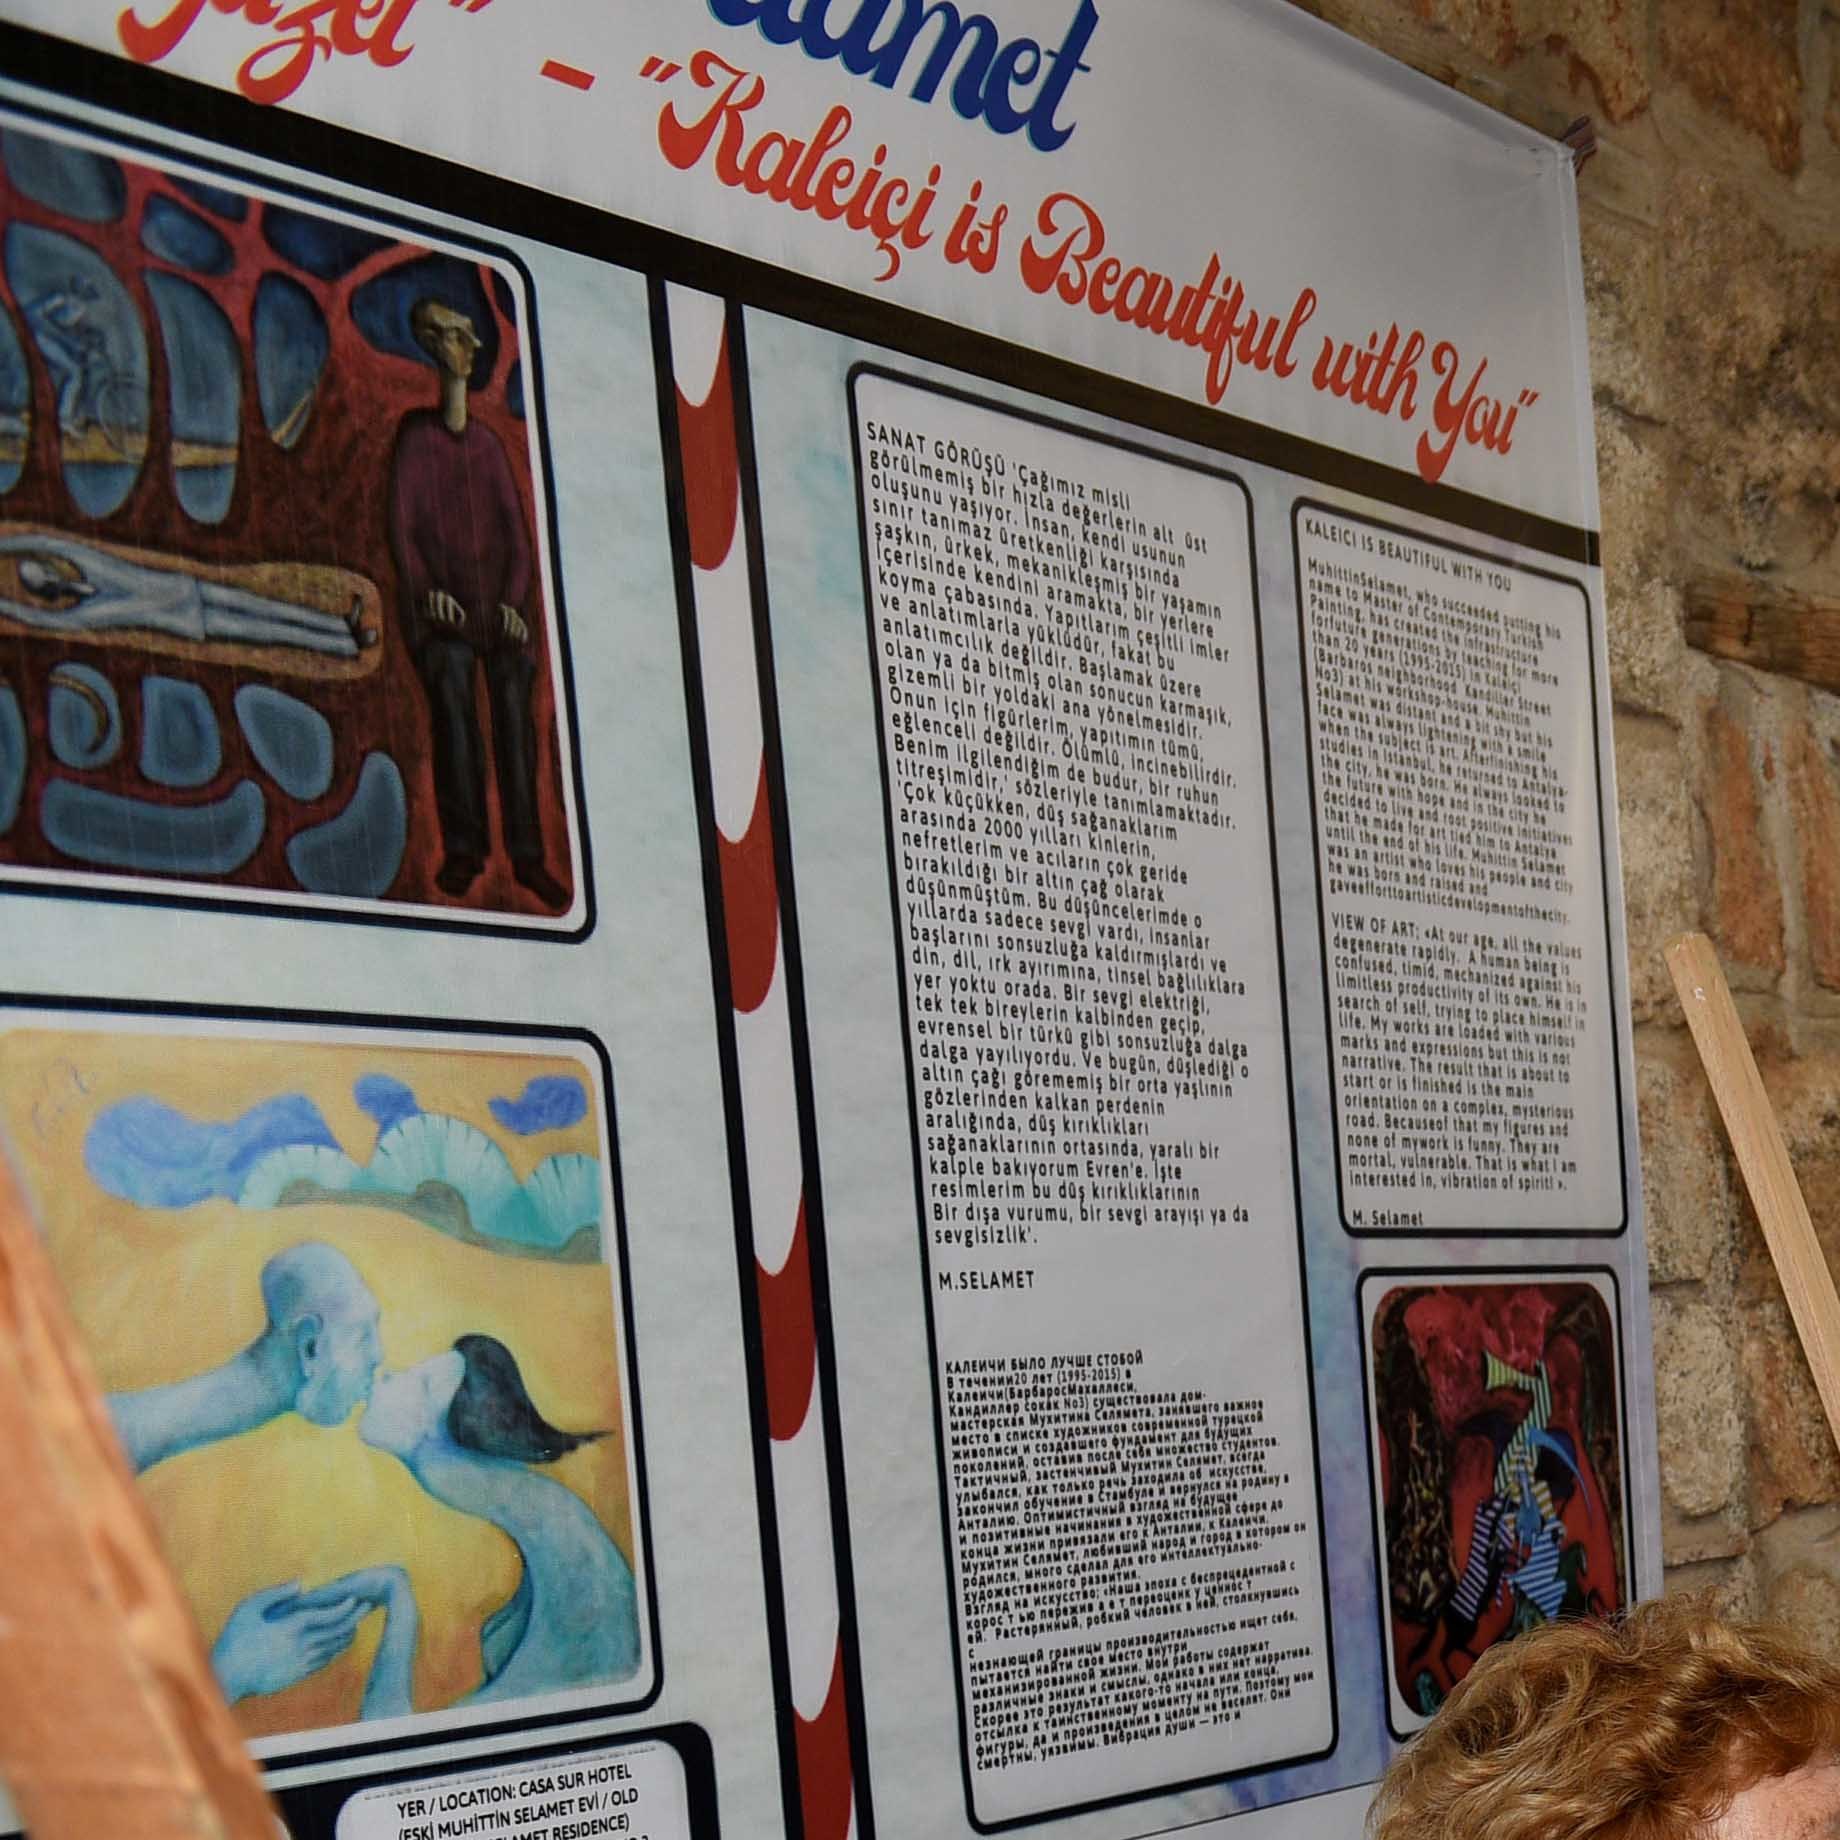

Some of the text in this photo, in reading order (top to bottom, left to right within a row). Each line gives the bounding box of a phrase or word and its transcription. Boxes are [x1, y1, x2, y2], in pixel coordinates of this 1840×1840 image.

[944, 180, 1010, 273] is
[1020, 192, 1316, 405] Beautiful
[1312, 326, 1424, 421] with
[866, 420, 926, 453] SANAT
[933, 439, 1005, 477] GÖRÜŞÜ
[1091, 487, 1130, 510] misli
[869, 449, 1206, 553] görülmemiş bir hızla değerlerin alt üst
[870, 472, 1185, 568] oluşunu yaşıyor. İnsan, kendi usunun
[872, 498, 914, 521] sınır
[921, 508, 992, 540] tanımaz
[1099, 551, 1179, 587] karşısında
[873, 522, 937, 553] şaşkın,
[943, 535, 999, 568] ürkek,
[1134, 582, 1156, 603] bir
[1161, 593, 1221, 619] yaşamın
[1305, 518, 1511, 592] KALEICI IS BEAUTIFUL WITH YOU
[875, 541, 1214, 637] içerisinde kendini aramakta, bir yerlere
[877, 564, 1229, 661] koyma çabasında. Yapıtlarım çeşitli imler
[879, 593, 900, 610] ve
[1026, 624, 1105, 658] yüklüdür,
[1110, 640, 1151, 665] fakat
[1156, 651, 1175, 670] bu
[1331, 912, 1365, 931] VIEW
[1369, 917, 1386, 933] OF
[1448, 930, 1468, 944] our
[1502, 935, 1518, 950] all
[1522, 938, 1542, 953] the
[1336, 994, 1380, 1010] search
[1384, 997, 1398, 1012] of
[1402, 999, 1430, 1018] self,
[1434, 1003, 1471, 1023] trying
[1475, 1008, 1488, 1021] to
[1492, 1008, 1525, 1025] place
[929, 1156, 1182, 1181] kalple bakıyorum Evren'e. İşte
[1346, 1132, 1559, 1156] none of mywork is funny. They are
[931, 1180, 1025, 1198] resimlerim
[1031, 1181, 1051, 1198] bu
[1057, 1182, 1086, 1203] düş
[932, 1203, 1249, 1224] Bir dışa vurumu, bir sevgi arayışı ya da
[1351, 1209, 1423, 1224] M. Selamet
[938, 1271, 1035, 1289] M.SELAMET
[396, 1798, 427, 1820] YER
[438, 1783, 516, 1812] LOCATION:
[518, 1776, 555, 1798] CASA
[556, 1770, 585, 1791] SUR
[587, 1762, 632, 1785] HOTEL
[437, 1808, 511, 1839] MUHİTTİN
[513, 1798, 575, 1825] SELAMET
[577, 1790, 599, 1813] EVİ
[610, 1786, 639, 1806] OLD
